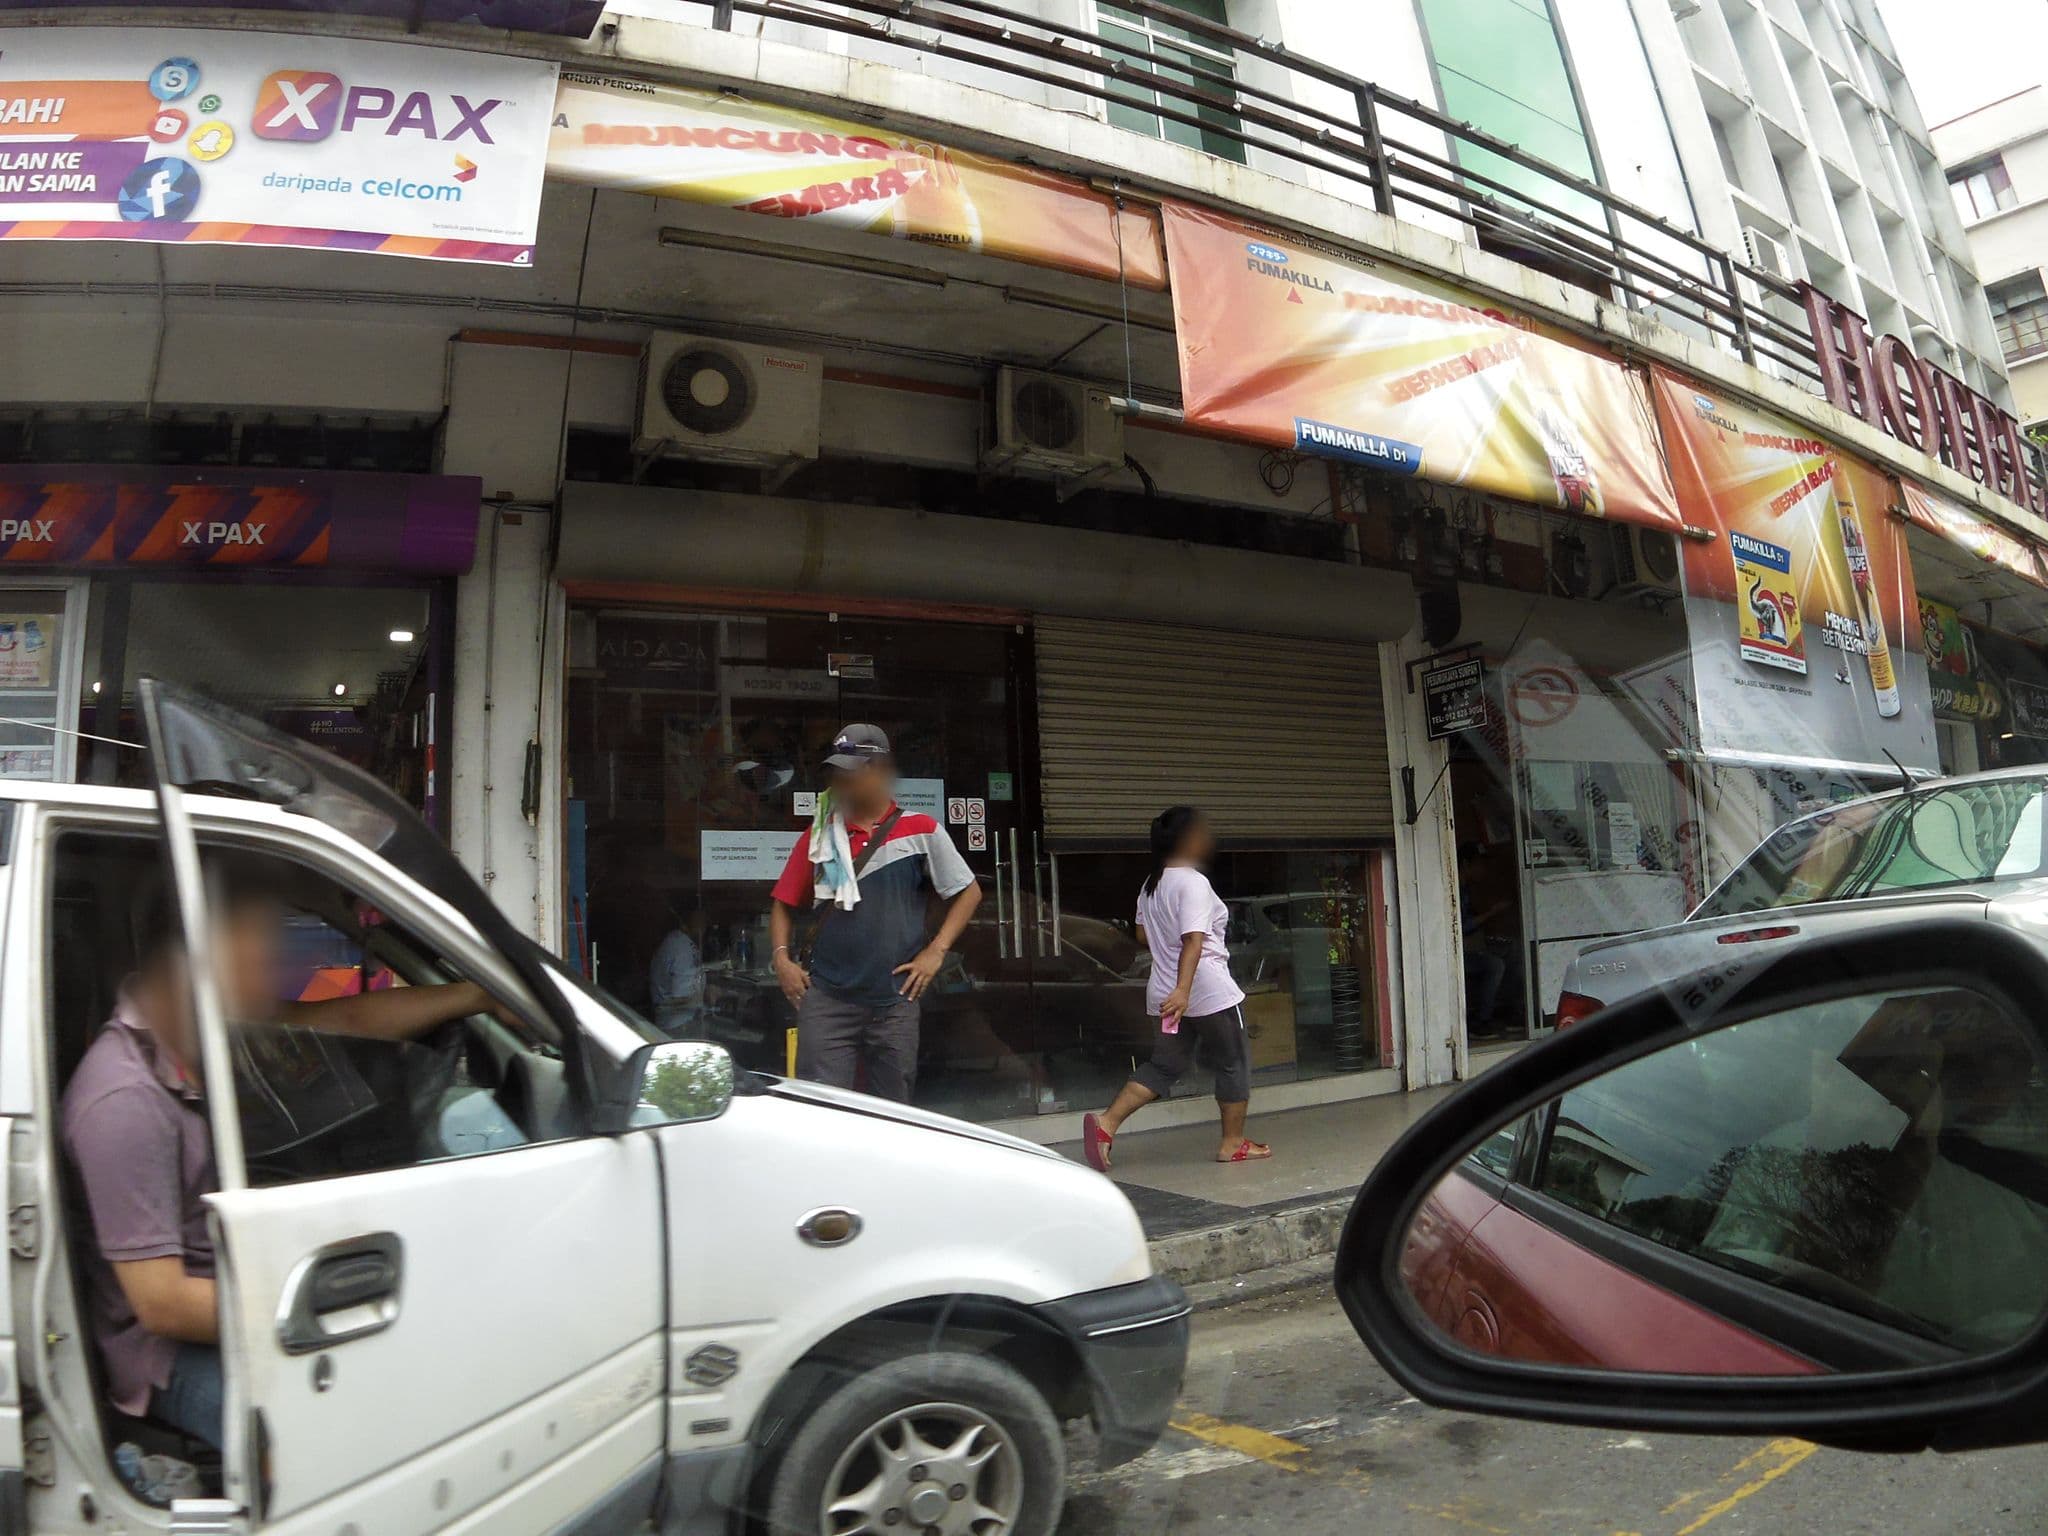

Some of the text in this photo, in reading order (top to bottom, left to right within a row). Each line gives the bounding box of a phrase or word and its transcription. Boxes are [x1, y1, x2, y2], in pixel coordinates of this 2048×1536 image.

[603, 78, 656, 95] PEROSAK
[51, 151, 83, 170] KE
[27, 174, 97, 193] SAMA
[262, 172, 462, 202] daripada celcom
[1247, 257, 1334, 294] FUMAKILLA
[1300, 422, 1407, 462] FUMAKILLA D1
[1, 520, 54, 541] PAX
[1732, 534, 1785, 563] FUMAKILLA D1
